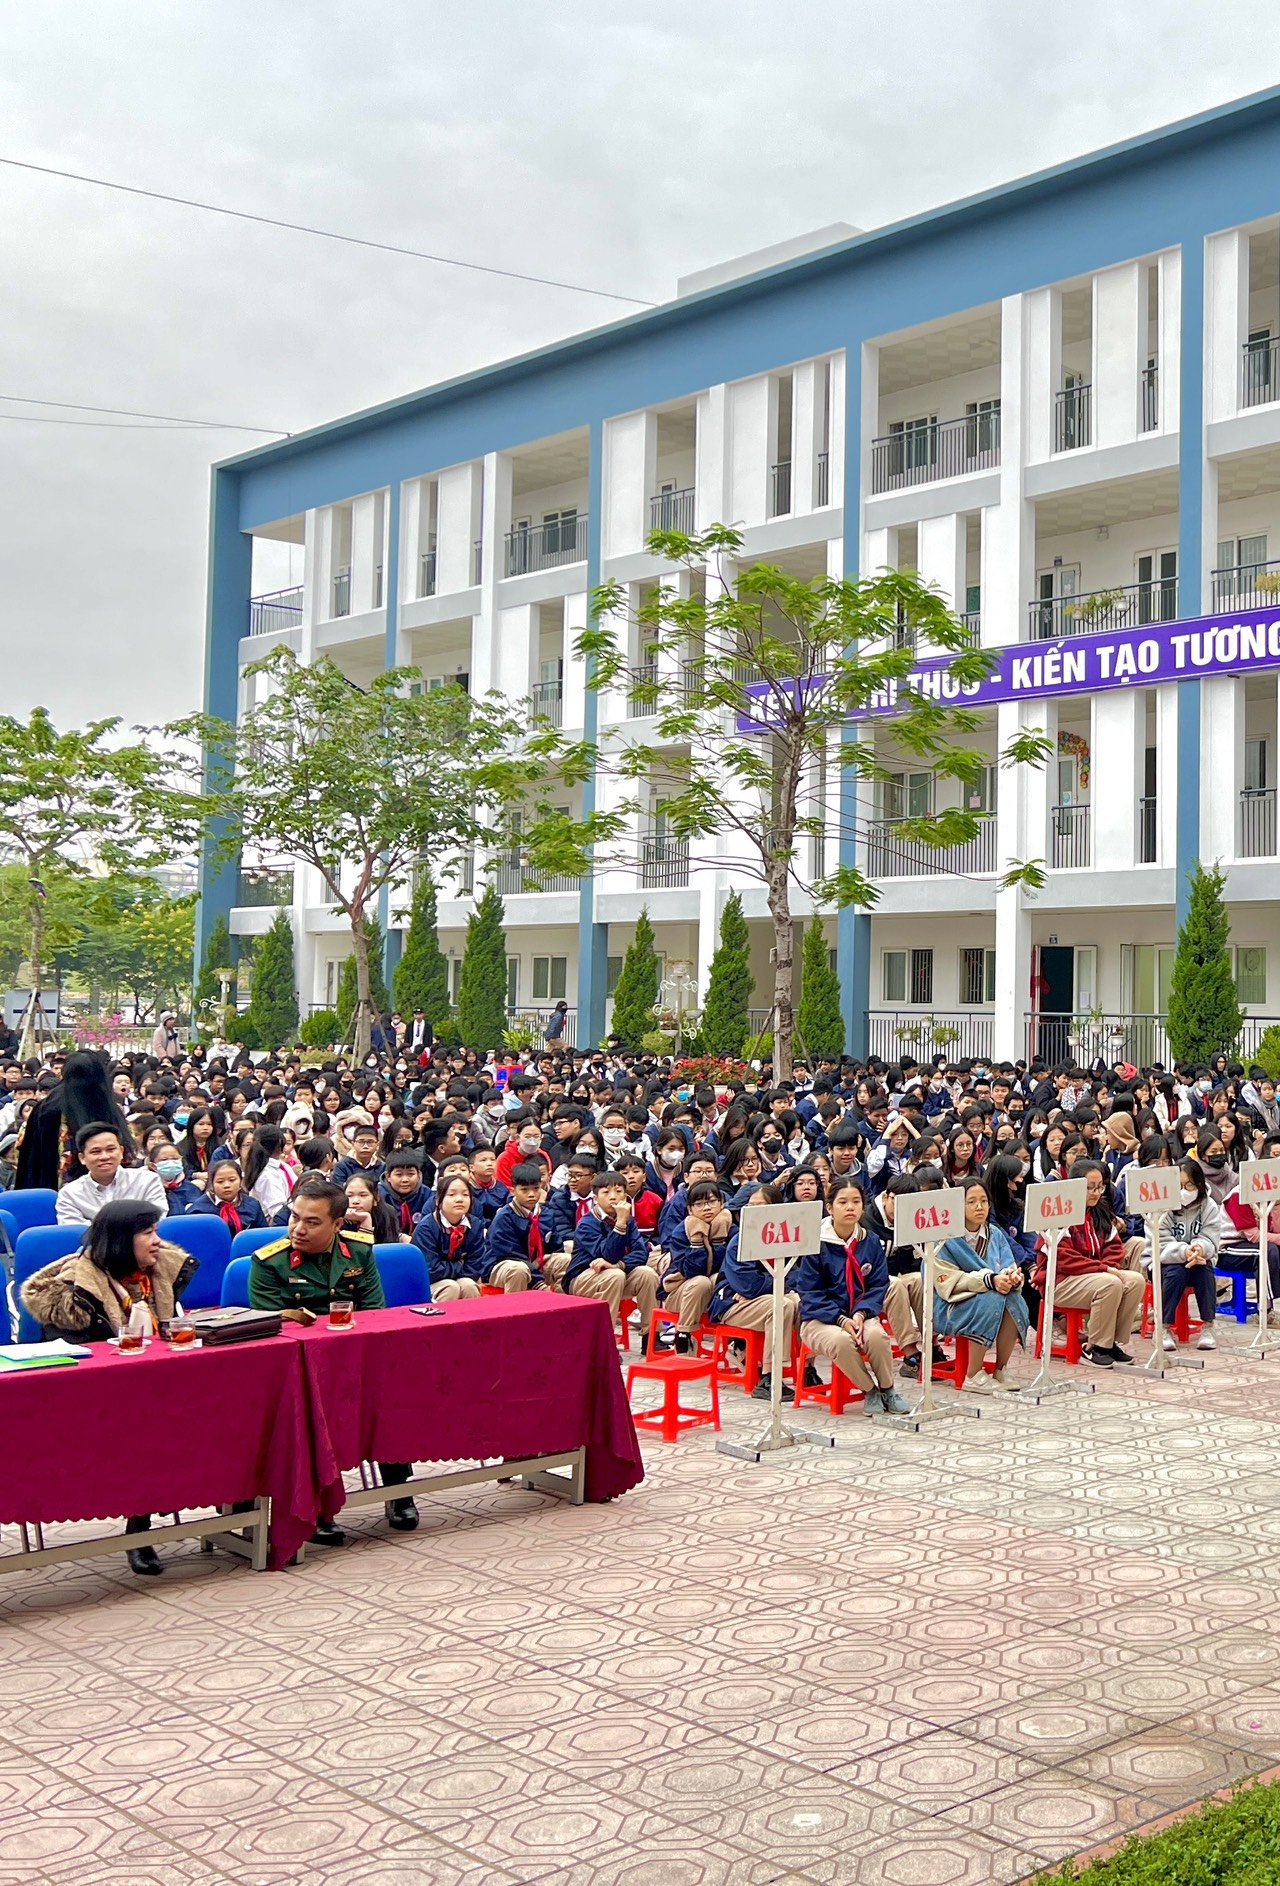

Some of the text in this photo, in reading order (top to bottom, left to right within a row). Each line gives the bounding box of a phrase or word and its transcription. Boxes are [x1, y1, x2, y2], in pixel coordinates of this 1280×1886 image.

[1011, 641, 1086, 690] KIẾN
[1096, 639, 1160, 684] TẠO
[1139, 1180, 1169, 1202] 8A1
[1252, 1171, 1279, 1192] 8A2
[914, 1205, 950, 1230] 6A2
[1040, 1194, 1073, 1217] 6A3
[761, 1219, 801, 1245] 6A1
